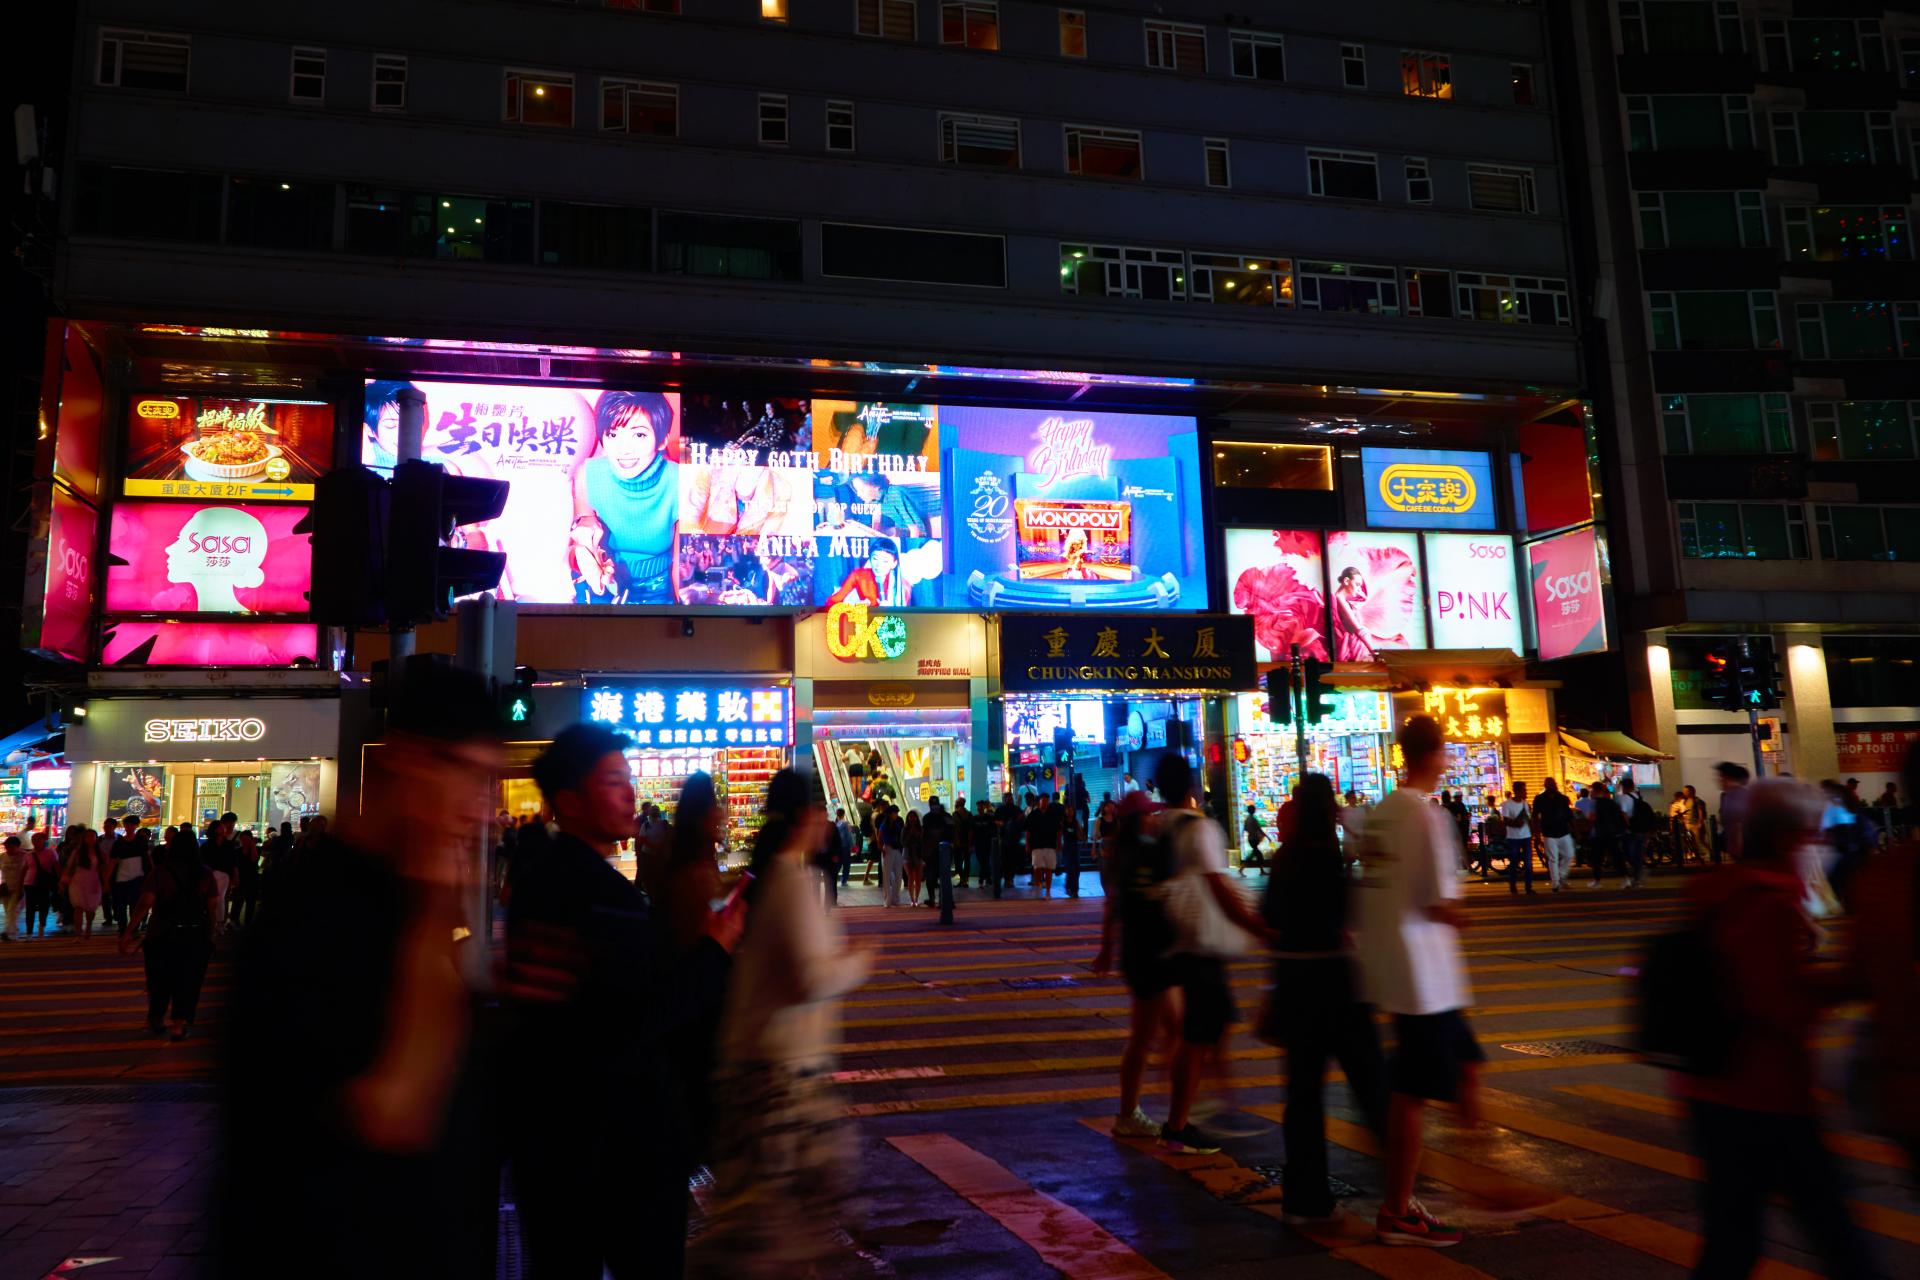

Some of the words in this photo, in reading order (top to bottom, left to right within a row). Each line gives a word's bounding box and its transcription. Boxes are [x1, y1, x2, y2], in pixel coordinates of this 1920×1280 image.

[436, 402, 578, 456] 生日快樂
[1037, 417, 1094, 447] Happy
[690, 443, 759, 466] HAPPY
[768, 451, 820, 472] 60TH
[828, 448, 929, 474] BIRTHDAY
[1032, 440, 1110, 488] Birthday
[226, 485, 248, 496] 2/F
[970, 494, 1009, 518] 20
[1028, 511, 1120, 528] MONOPOLY
[755, 533, 819, 557] ANITA
[828, 534, 870, 558] MUI
[206, 556, 231, 567] 莎莎
[1438, 591, 1513, 621] P!NK
[1560, 599, 1581, 616] 莎莎
[1027, 665, 1139, 681] CHUNGKING
[1142, 665, 1233, 681] MANSIONS
[145, 718, 265, 742] SEIKO
